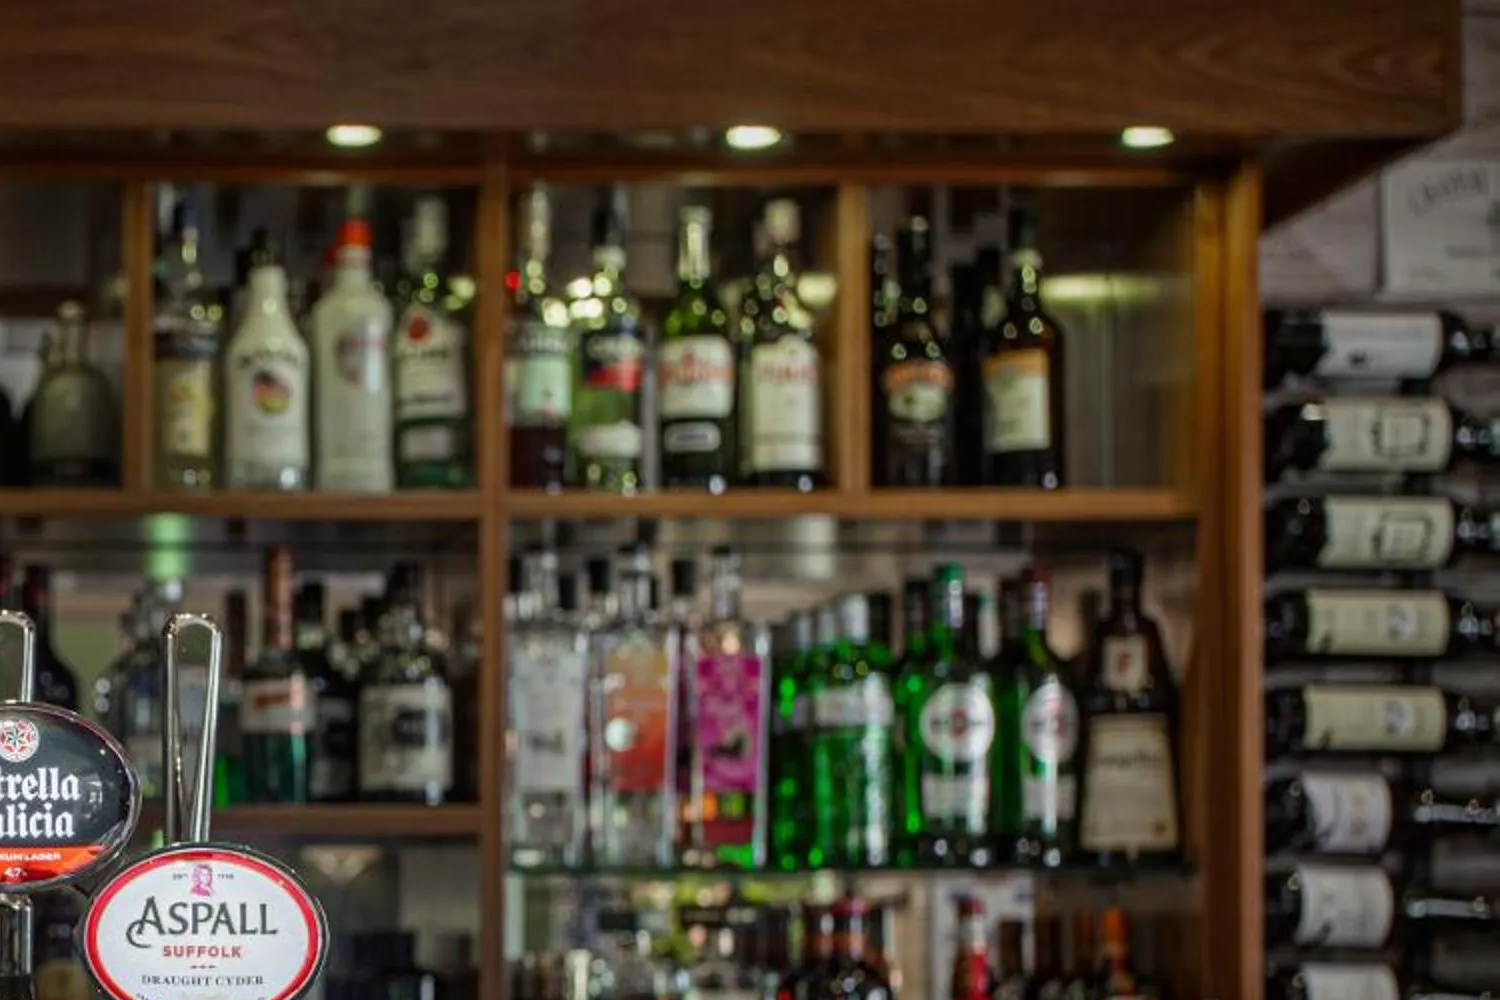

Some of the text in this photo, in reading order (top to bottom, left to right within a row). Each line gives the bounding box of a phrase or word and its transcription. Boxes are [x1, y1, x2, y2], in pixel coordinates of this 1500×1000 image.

[126, 895, 279, 949] ASPALL
[163, 945, 242, 959] SUFFOLK
[141, 974, 264, 987] DRAUGHT CYDER
